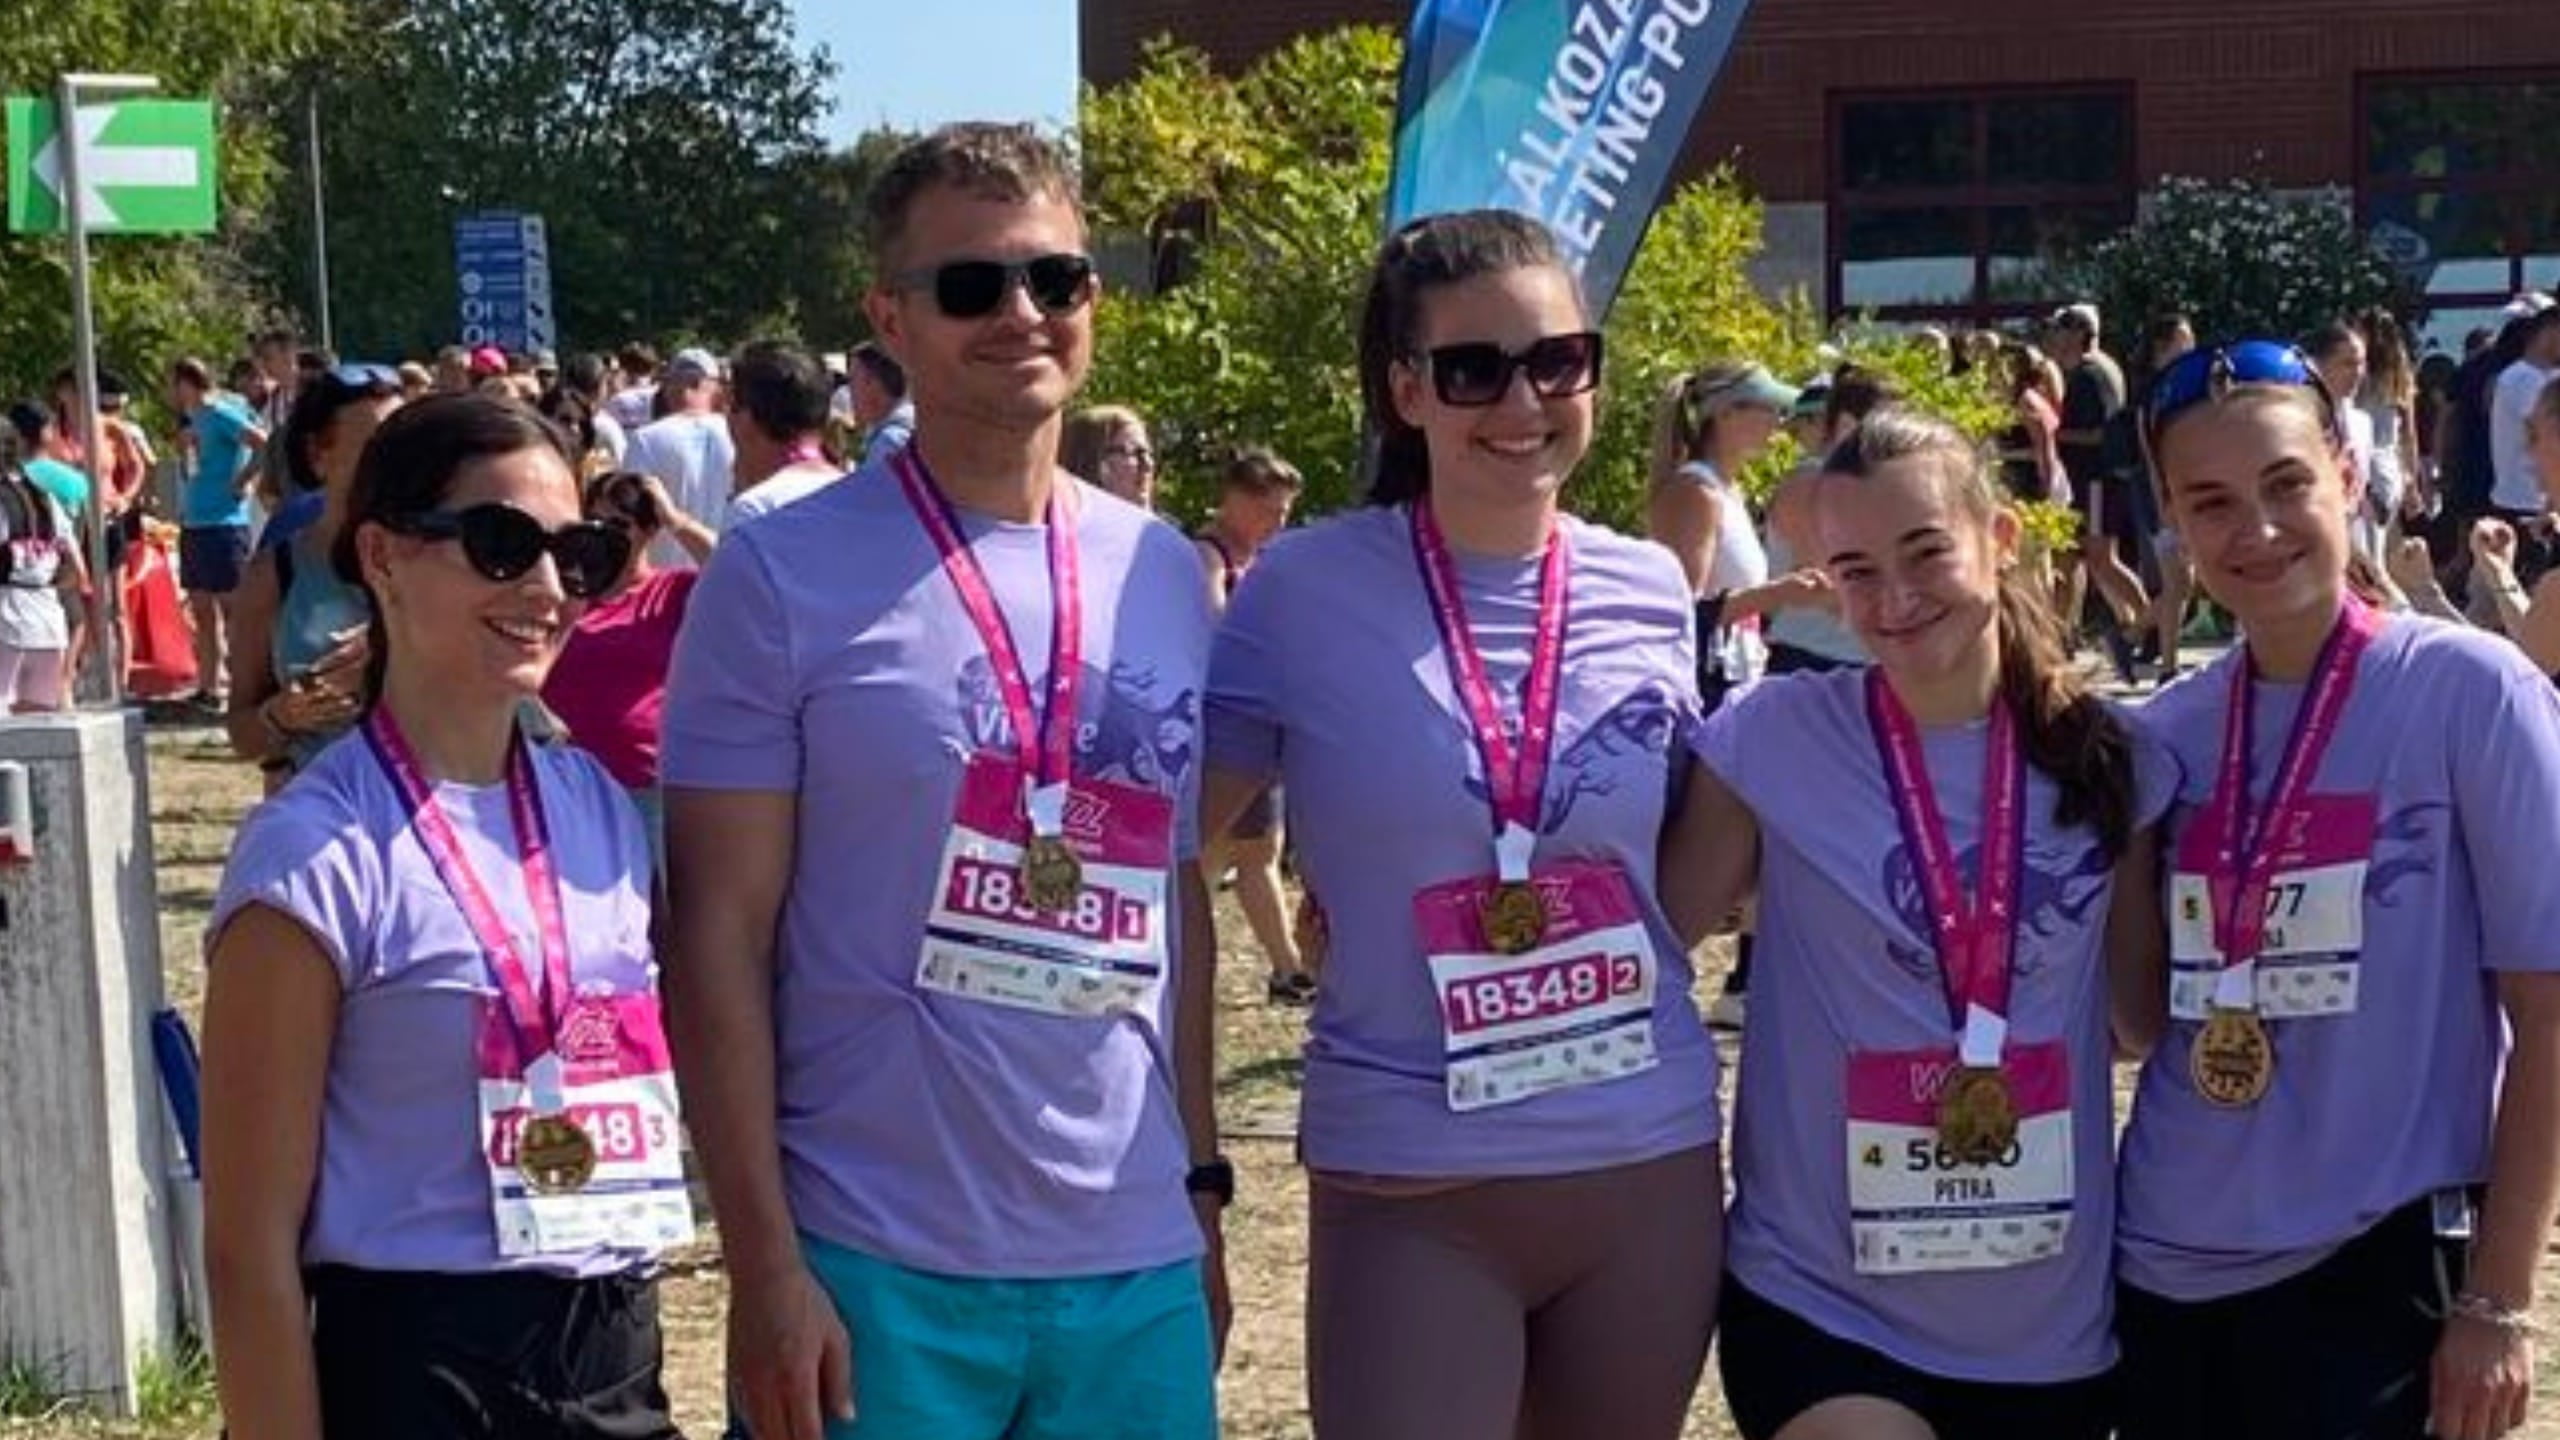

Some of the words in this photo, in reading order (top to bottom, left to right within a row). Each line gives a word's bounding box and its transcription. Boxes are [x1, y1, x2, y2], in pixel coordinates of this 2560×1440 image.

[960, 866, 1103, 933] 188
[1451, 962, 1599, 1025] 18348
[1613, 960, 1639, 990] 2
[646, 1114, 667, 1148] 3
[1861, 1144, 1884, 1167] 4
[1934, 1177, 1997, 1203] PETRA
